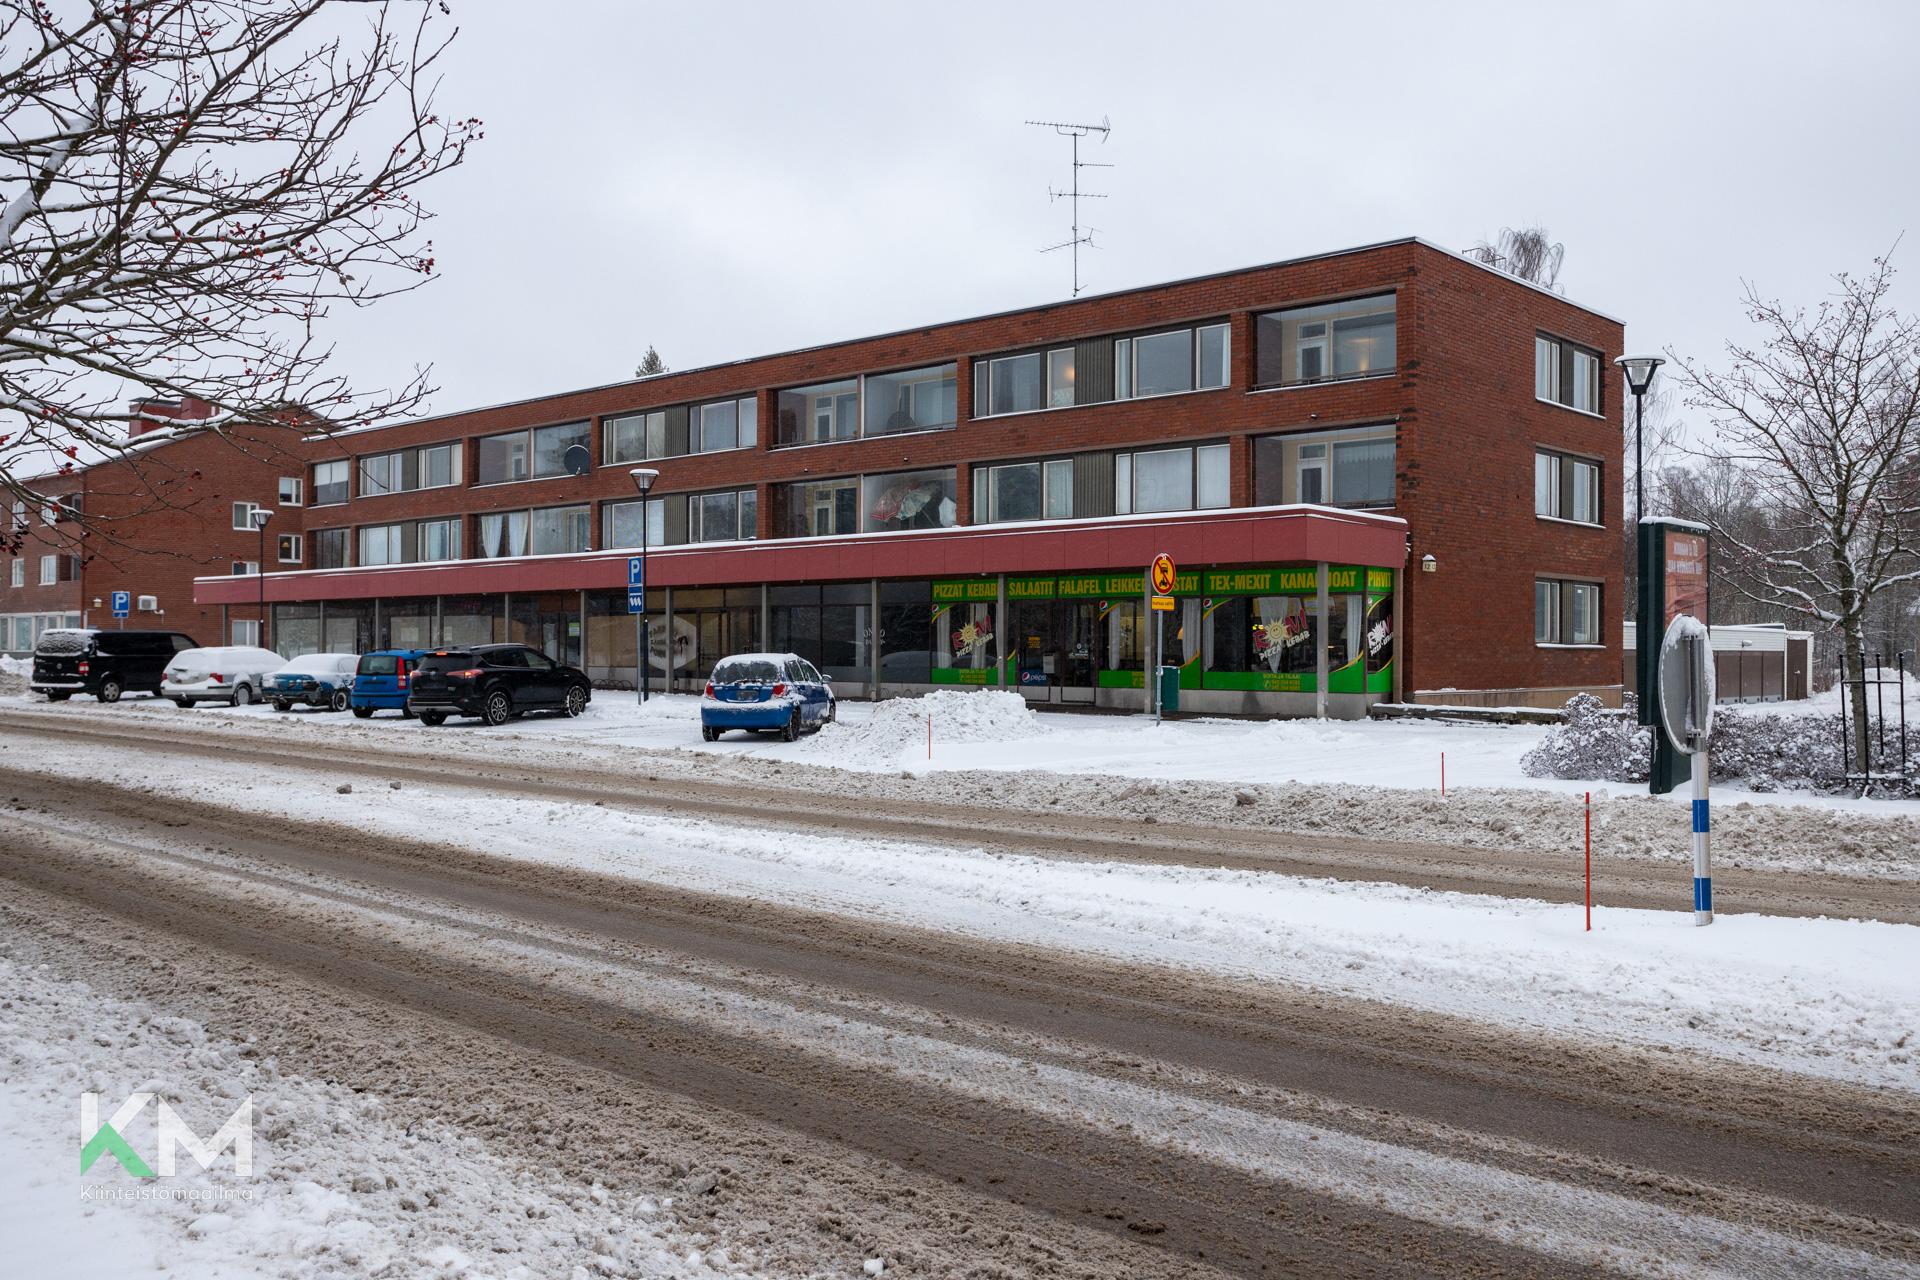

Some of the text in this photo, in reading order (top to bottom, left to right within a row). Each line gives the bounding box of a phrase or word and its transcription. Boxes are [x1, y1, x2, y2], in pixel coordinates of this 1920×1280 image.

[631, 559, 640, 583] P
[1368, 571, 1392, 587] PIHVIT
[934, 583, 999, 598] PIZZAT KEBAB
[1009, 581, 1054, 596] SALAATIT
[1058, 578, 1101, 594] FALAFEL
[1210, 574, 1271, 591] TEX-MEXIT
[115, 593, 127, 610] P
[956, 645, 973, 658] PIZZA
[1259, 631, 1310, 661] PIZZA KEBAB
